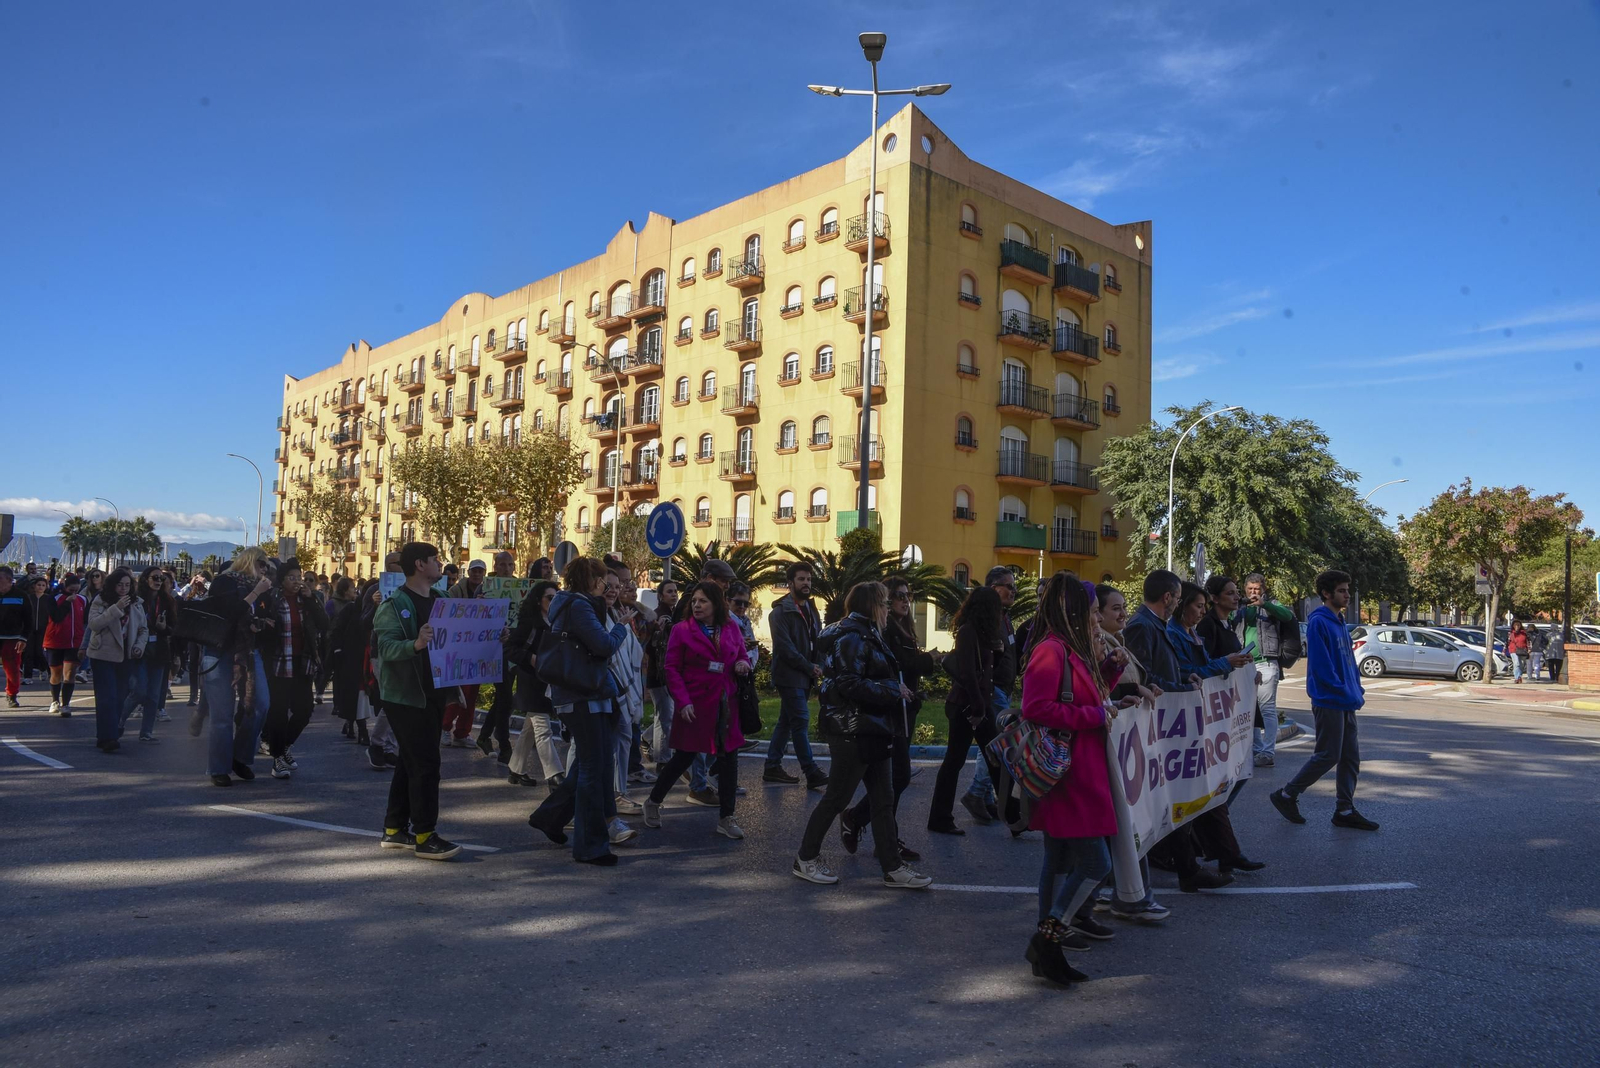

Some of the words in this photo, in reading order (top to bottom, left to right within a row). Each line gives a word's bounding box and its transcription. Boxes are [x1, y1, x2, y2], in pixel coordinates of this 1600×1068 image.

[429, 627, 447, 651] NO
[463, 630, 475, 643] TU
[478, 628, 502, 643] EXCUS
[1157, 707, 1187, 739] LA
